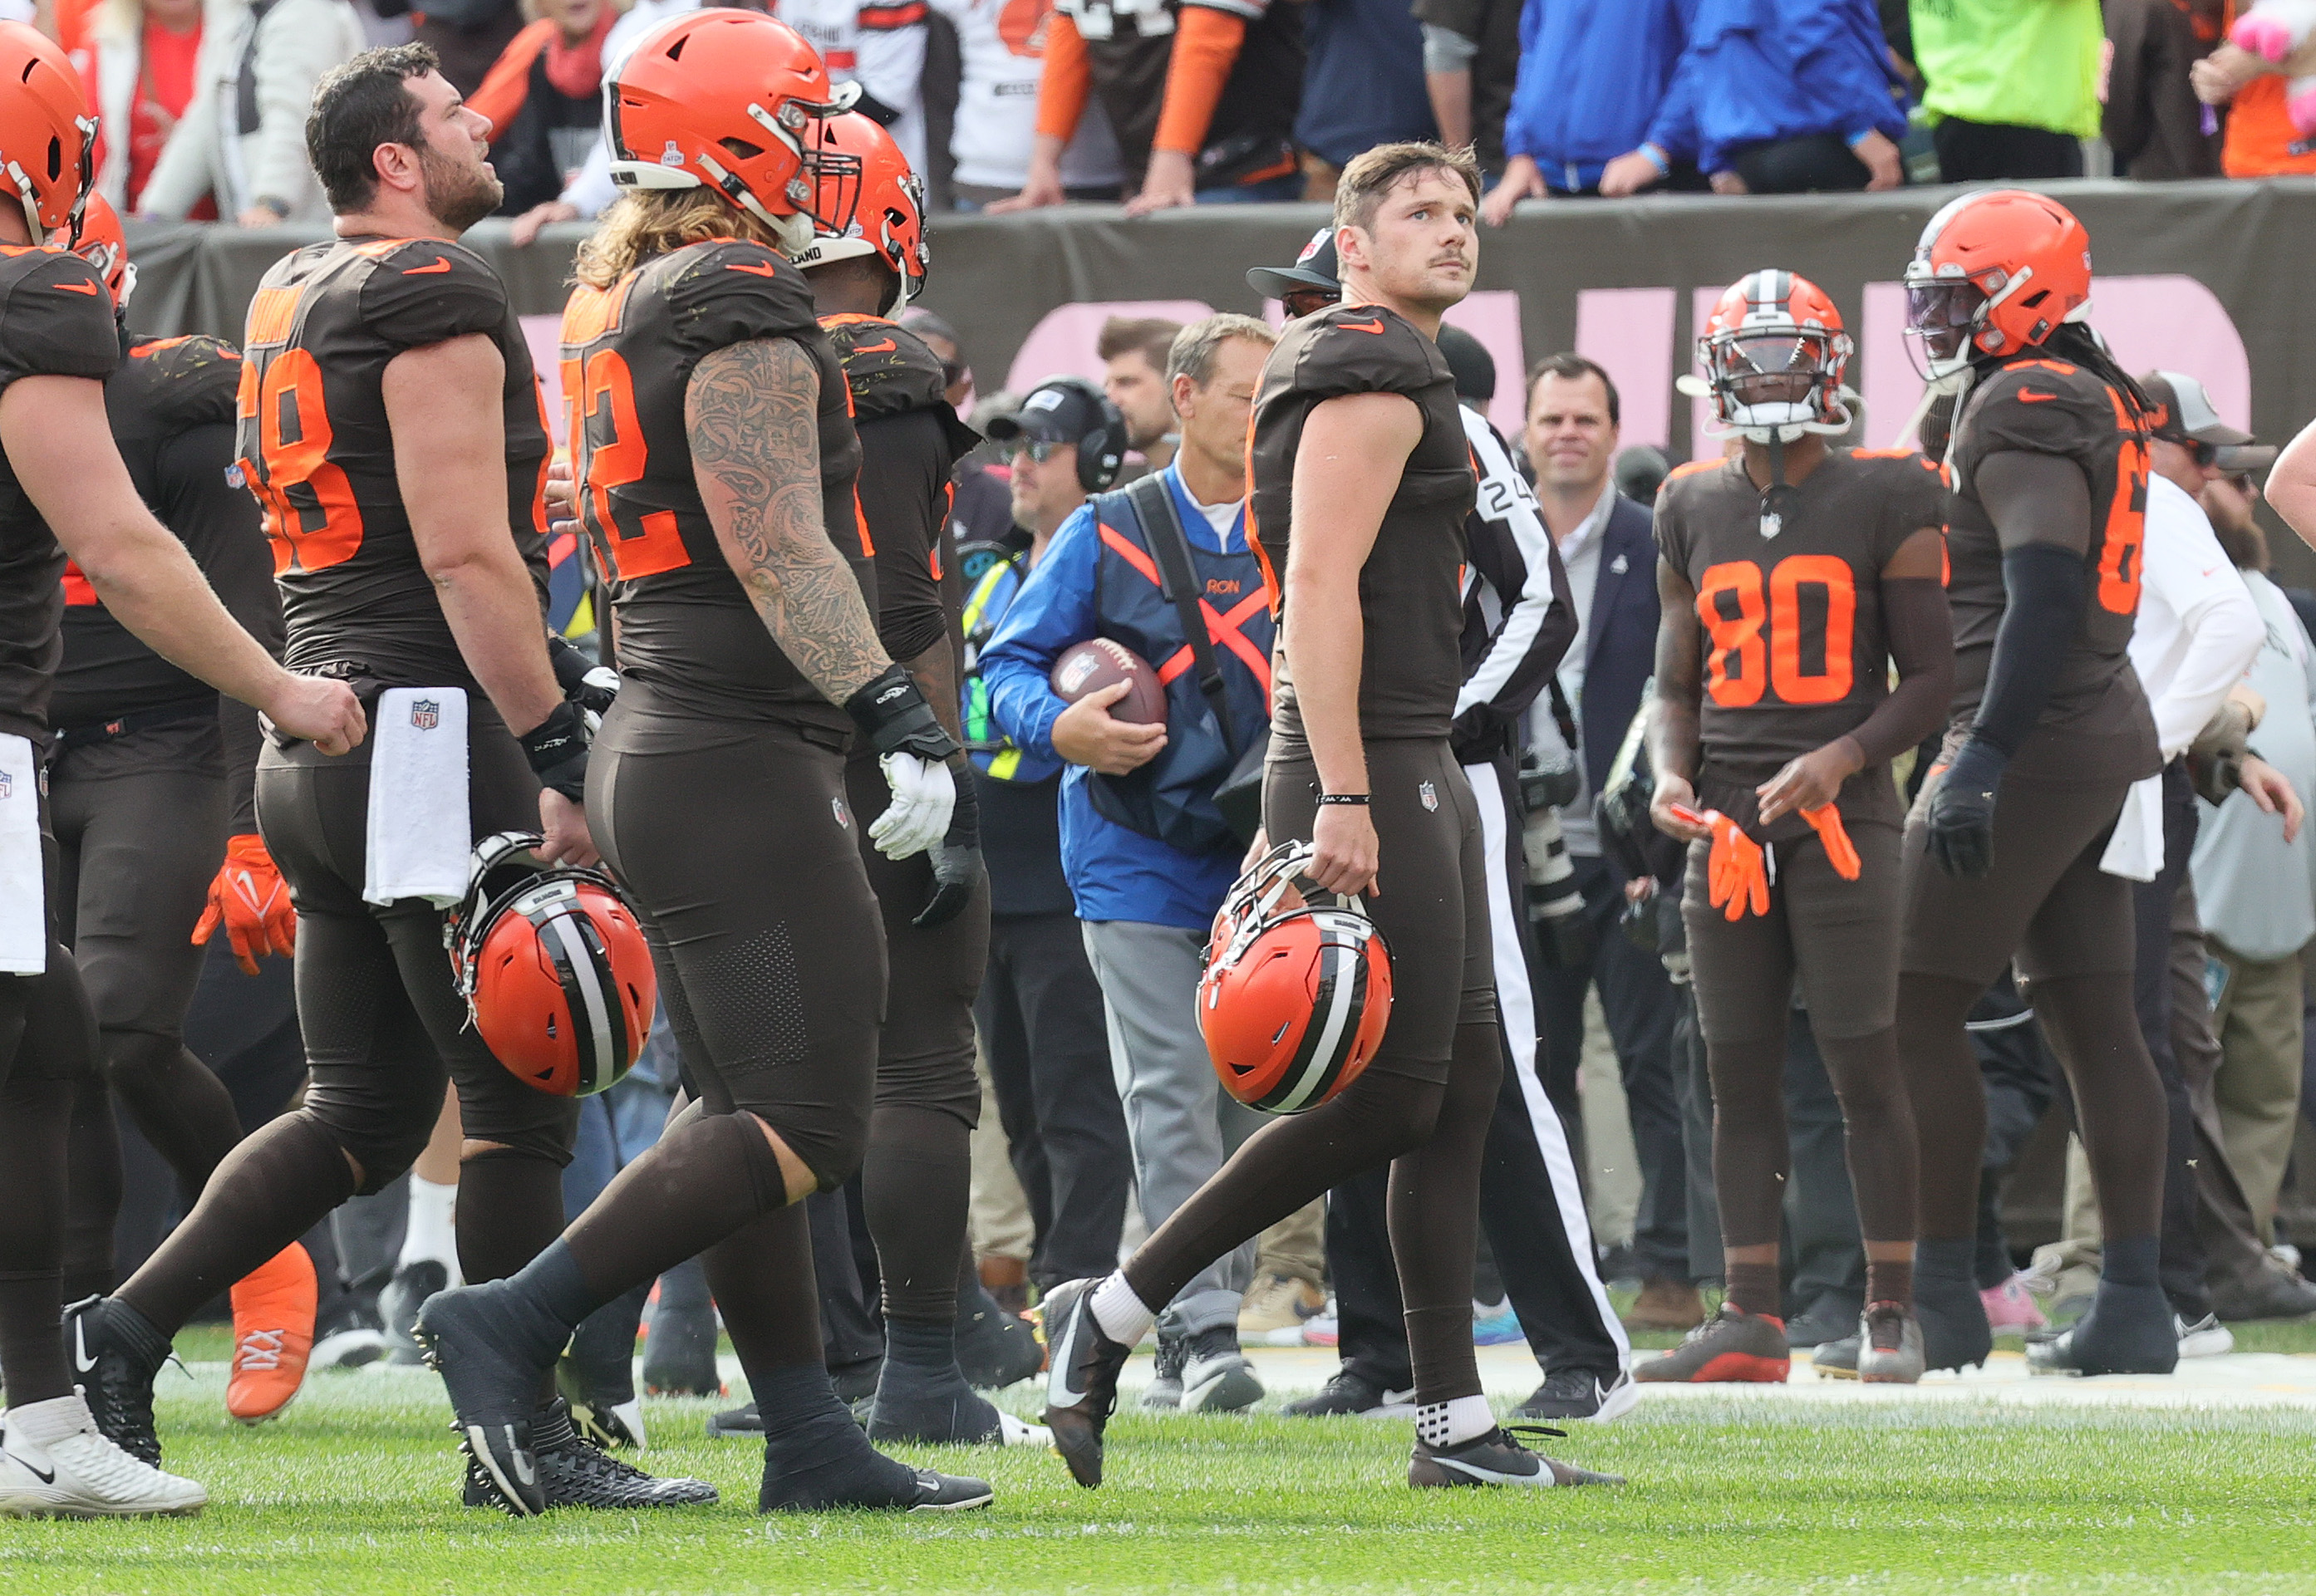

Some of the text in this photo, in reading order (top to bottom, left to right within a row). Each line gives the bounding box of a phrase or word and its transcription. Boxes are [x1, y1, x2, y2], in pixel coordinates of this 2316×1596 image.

[1483, 475, 1534, 513] 24
[1696, 554, 1857, 708] 80
[414, 712, 436, 728] NFL
[0, 783, 11, 798] FL
